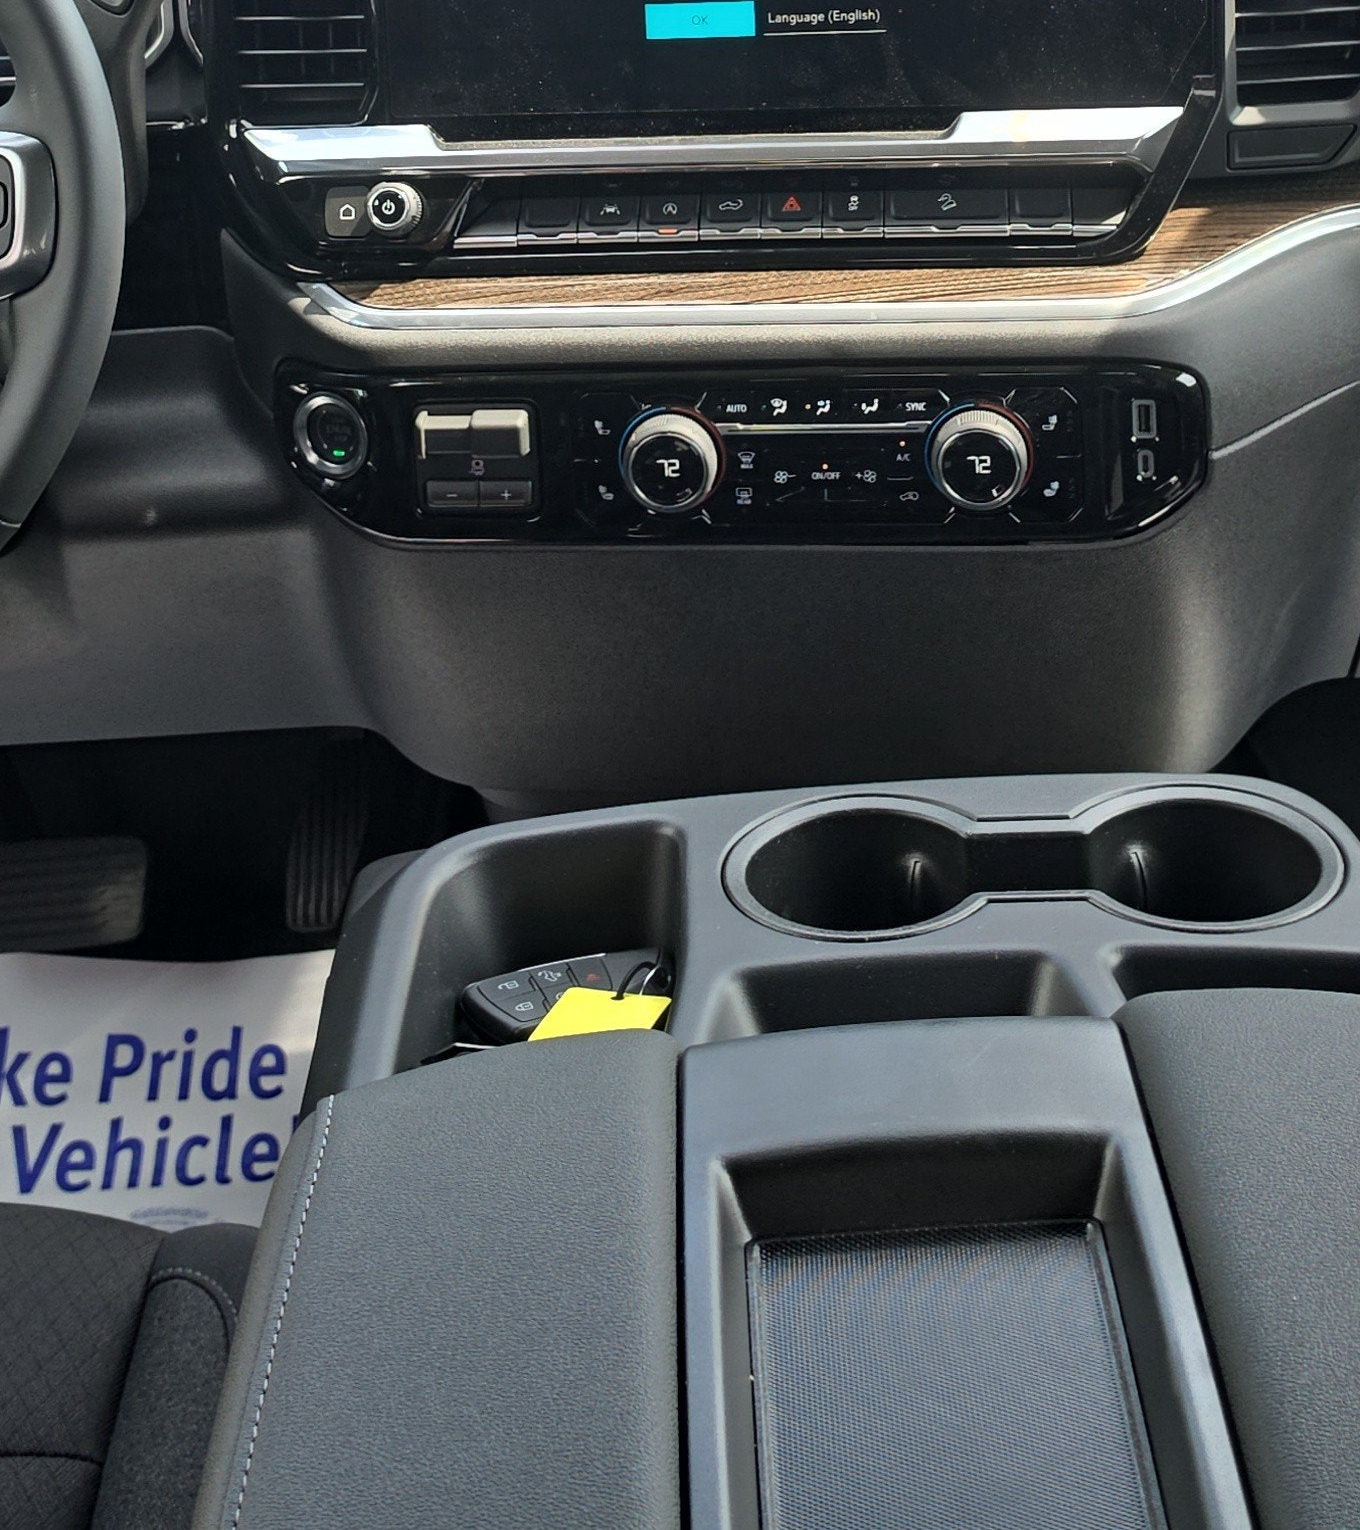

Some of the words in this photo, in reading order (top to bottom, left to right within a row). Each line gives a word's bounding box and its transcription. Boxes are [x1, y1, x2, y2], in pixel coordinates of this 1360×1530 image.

[691, 14, 709, 27] OK
[767, 10, 825, 27] Language
[827, 8, 881, 25] (English)
[726, 403, 747, 414] AUTO
[904, 401, 927, 413] SYNC
[896, 453, 911, 463] A/C
[966, 455, 992, 474] 72
[656, 459, 681, 478] 72
[811, 471, 841, 481] ON/OFF
[97, 1025, 287, 1105] Pride
[12, 1114, 300, 1196] Vehicle
